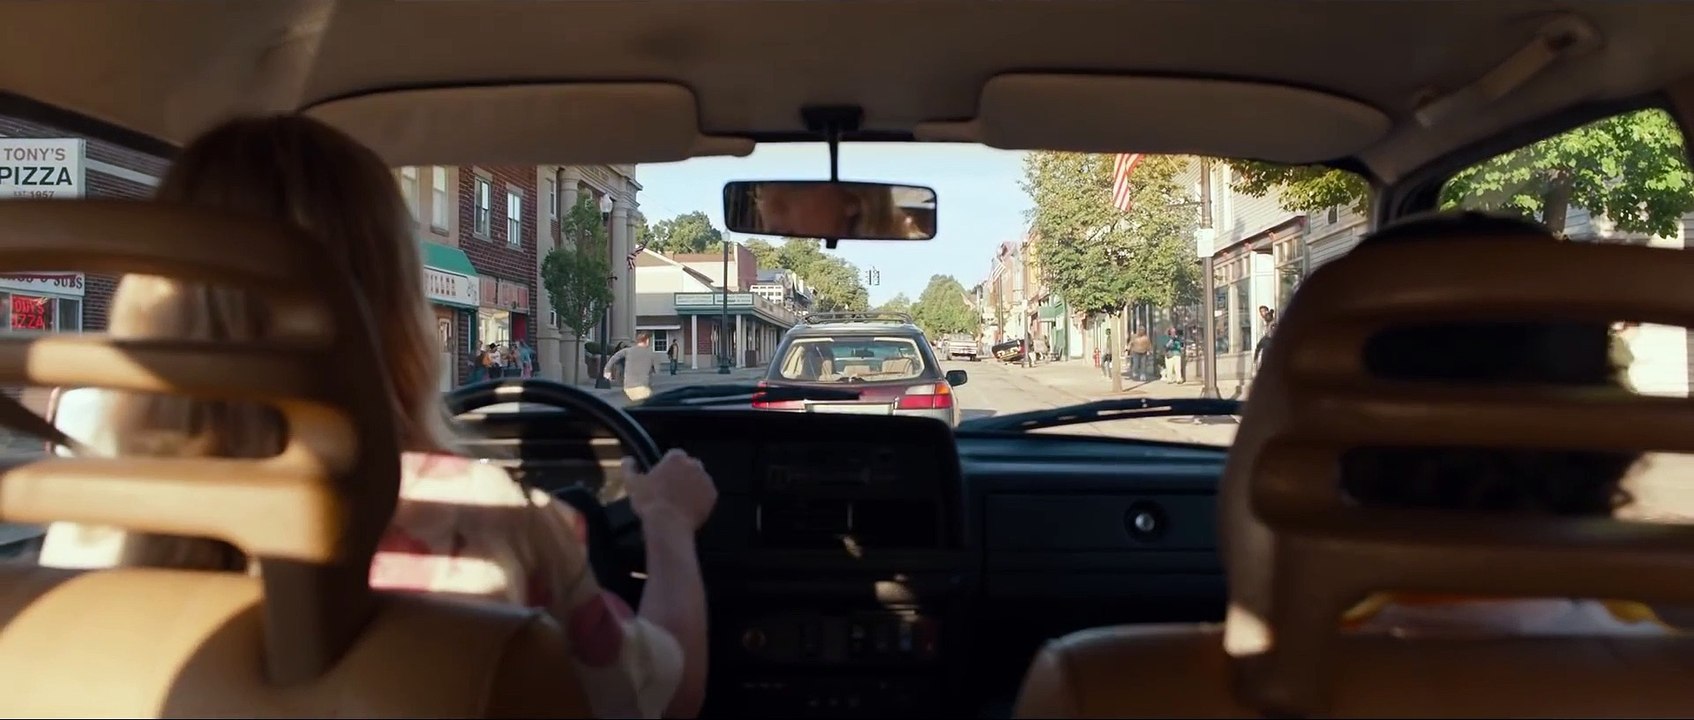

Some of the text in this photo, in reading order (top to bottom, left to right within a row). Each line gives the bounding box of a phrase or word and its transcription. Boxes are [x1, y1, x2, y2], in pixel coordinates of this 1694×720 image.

[4, 148, 66, 161] TONY'S
[0, 166, 73, 186] PIZZA
[30, 191, 54, 199] 1957
